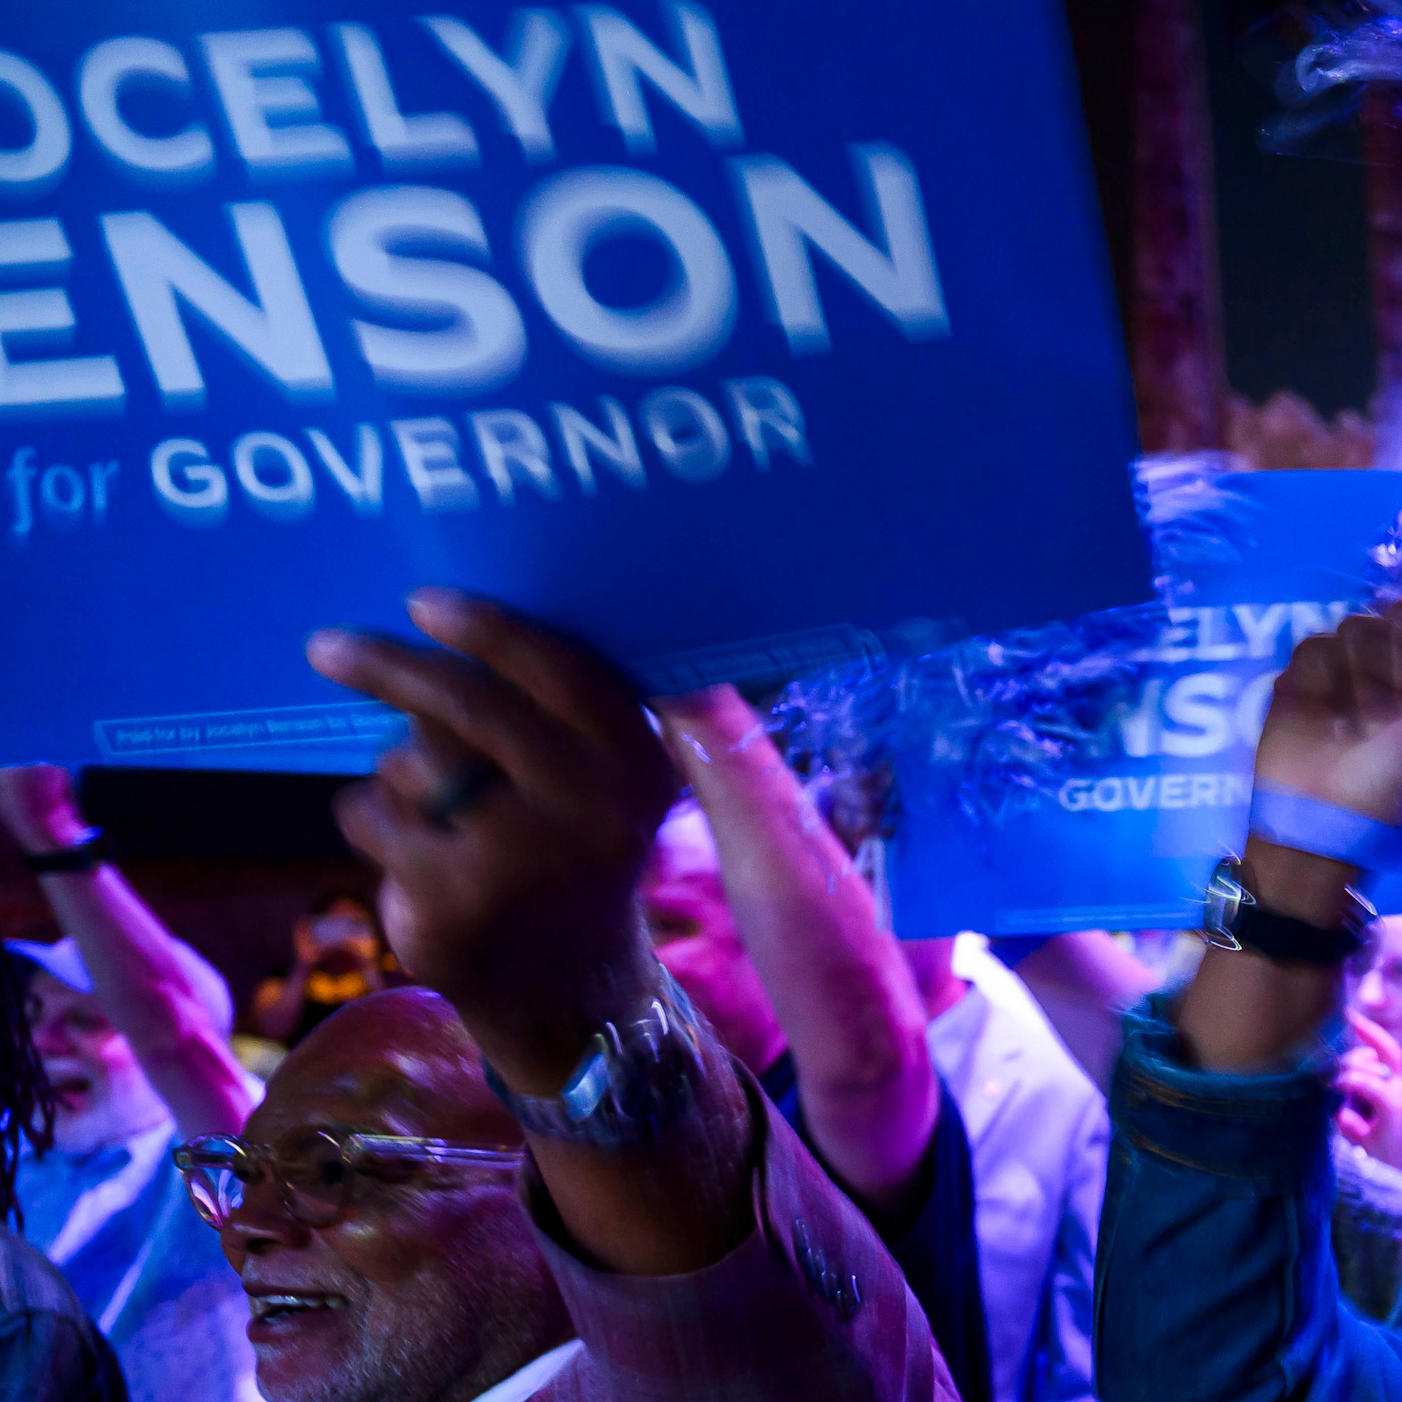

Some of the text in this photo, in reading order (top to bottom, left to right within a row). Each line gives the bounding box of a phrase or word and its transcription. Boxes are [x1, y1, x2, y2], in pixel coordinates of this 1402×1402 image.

[0, 2, 746, 184] OCELYN
[0, 142, 952, 405] ENSON
[9, 377, 810, 537] for GOVERNOR
